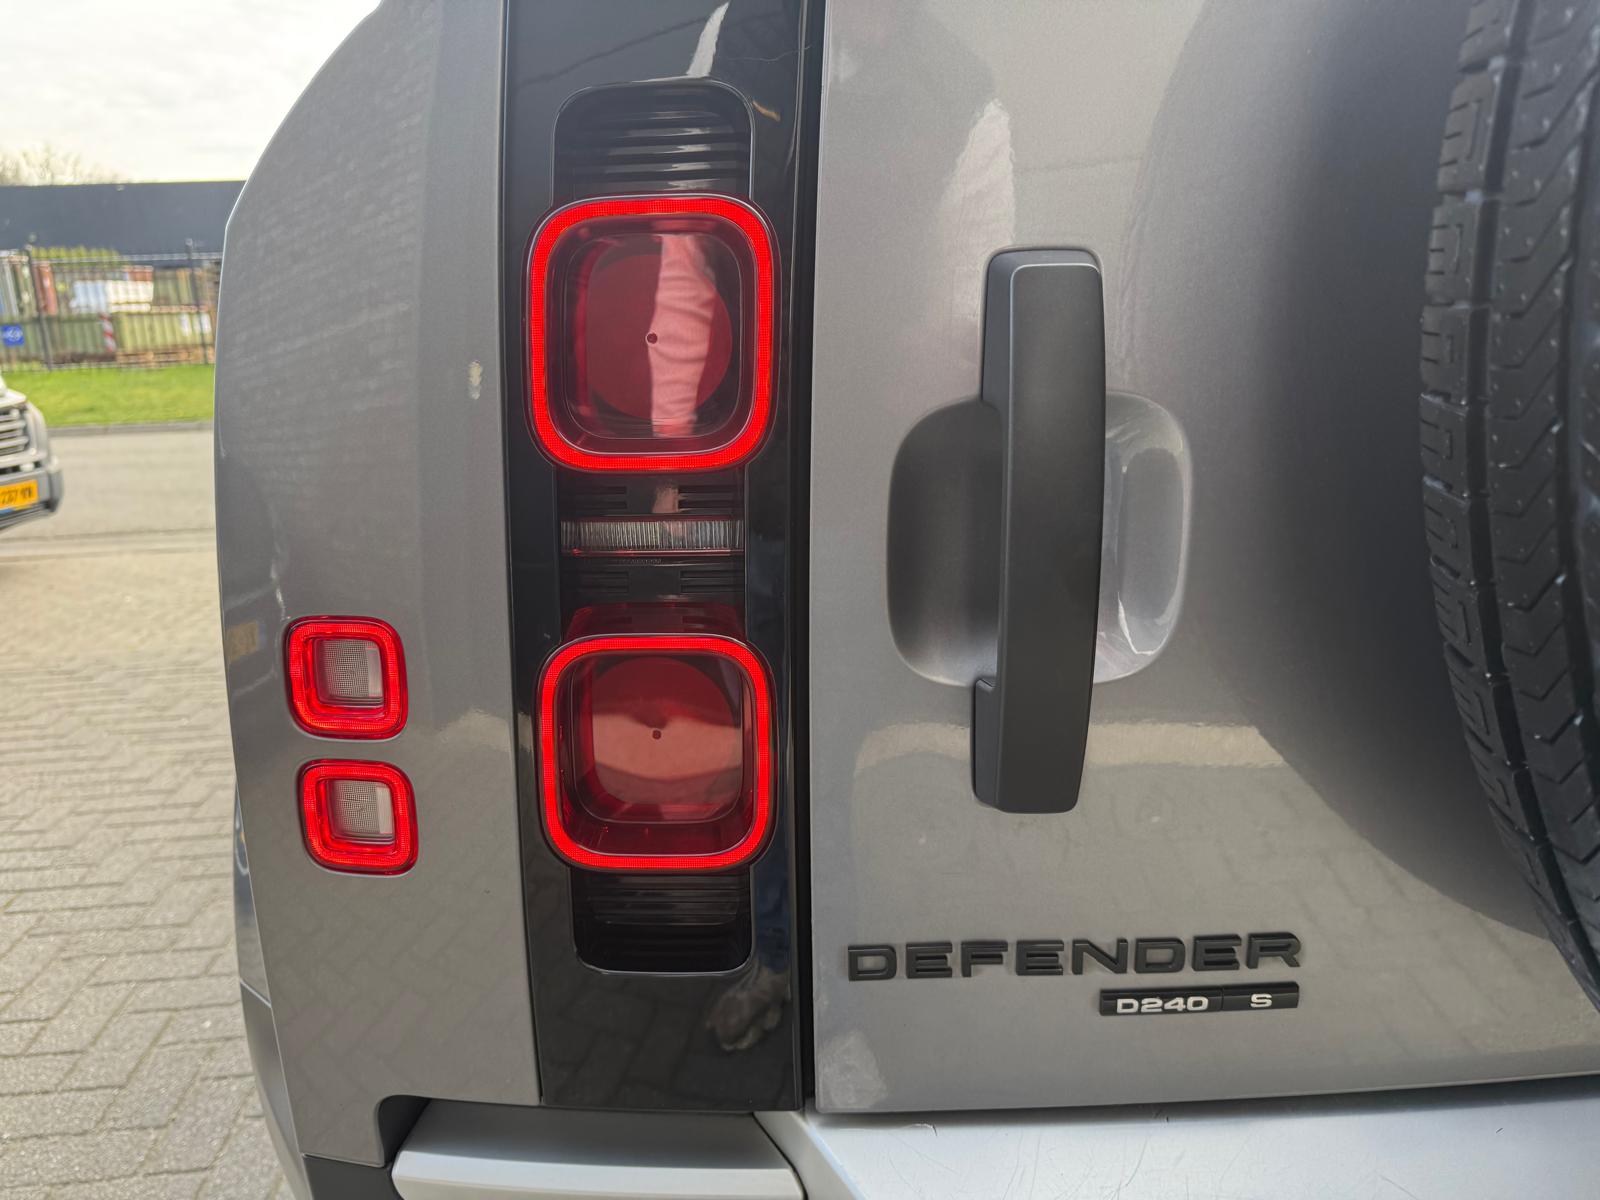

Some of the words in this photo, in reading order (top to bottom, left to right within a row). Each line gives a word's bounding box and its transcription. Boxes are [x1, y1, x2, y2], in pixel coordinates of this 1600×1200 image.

[848, 931, 1300, 982] DEFENDER
[1116, 996, 1209, 1014] D240
[1250, 993, 1273, 1009] S
